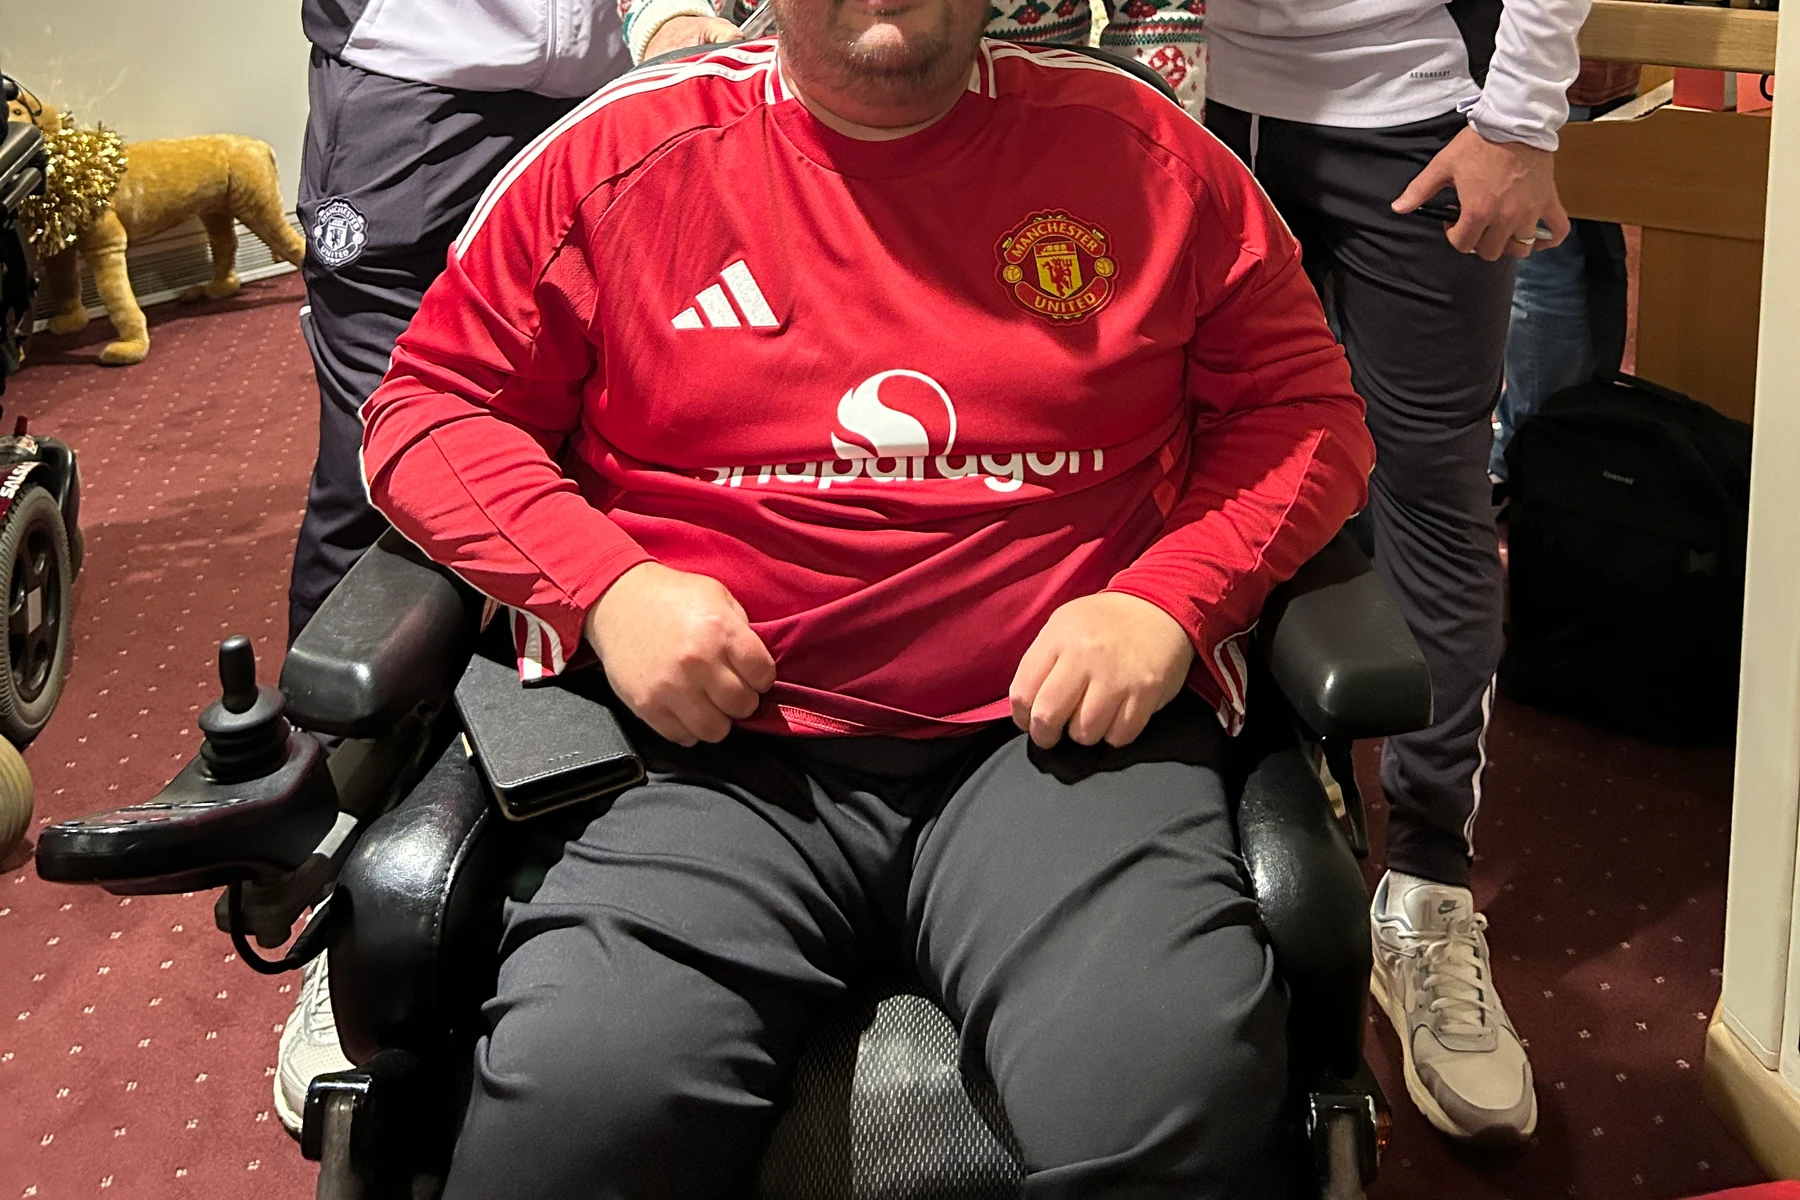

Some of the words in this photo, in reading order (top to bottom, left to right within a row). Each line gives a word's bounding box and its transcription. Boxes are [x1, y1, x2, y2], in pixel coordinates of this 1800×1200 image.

[1410, 70, 1451, 79] AEROREADY
[320, 206, 360, 230] MANCHESTER
[1011, 222, 1098, 257] MANCHESTER
[320, 246, 349, 258] UNITED
[1034, 292, 1096, 312] UNITED
